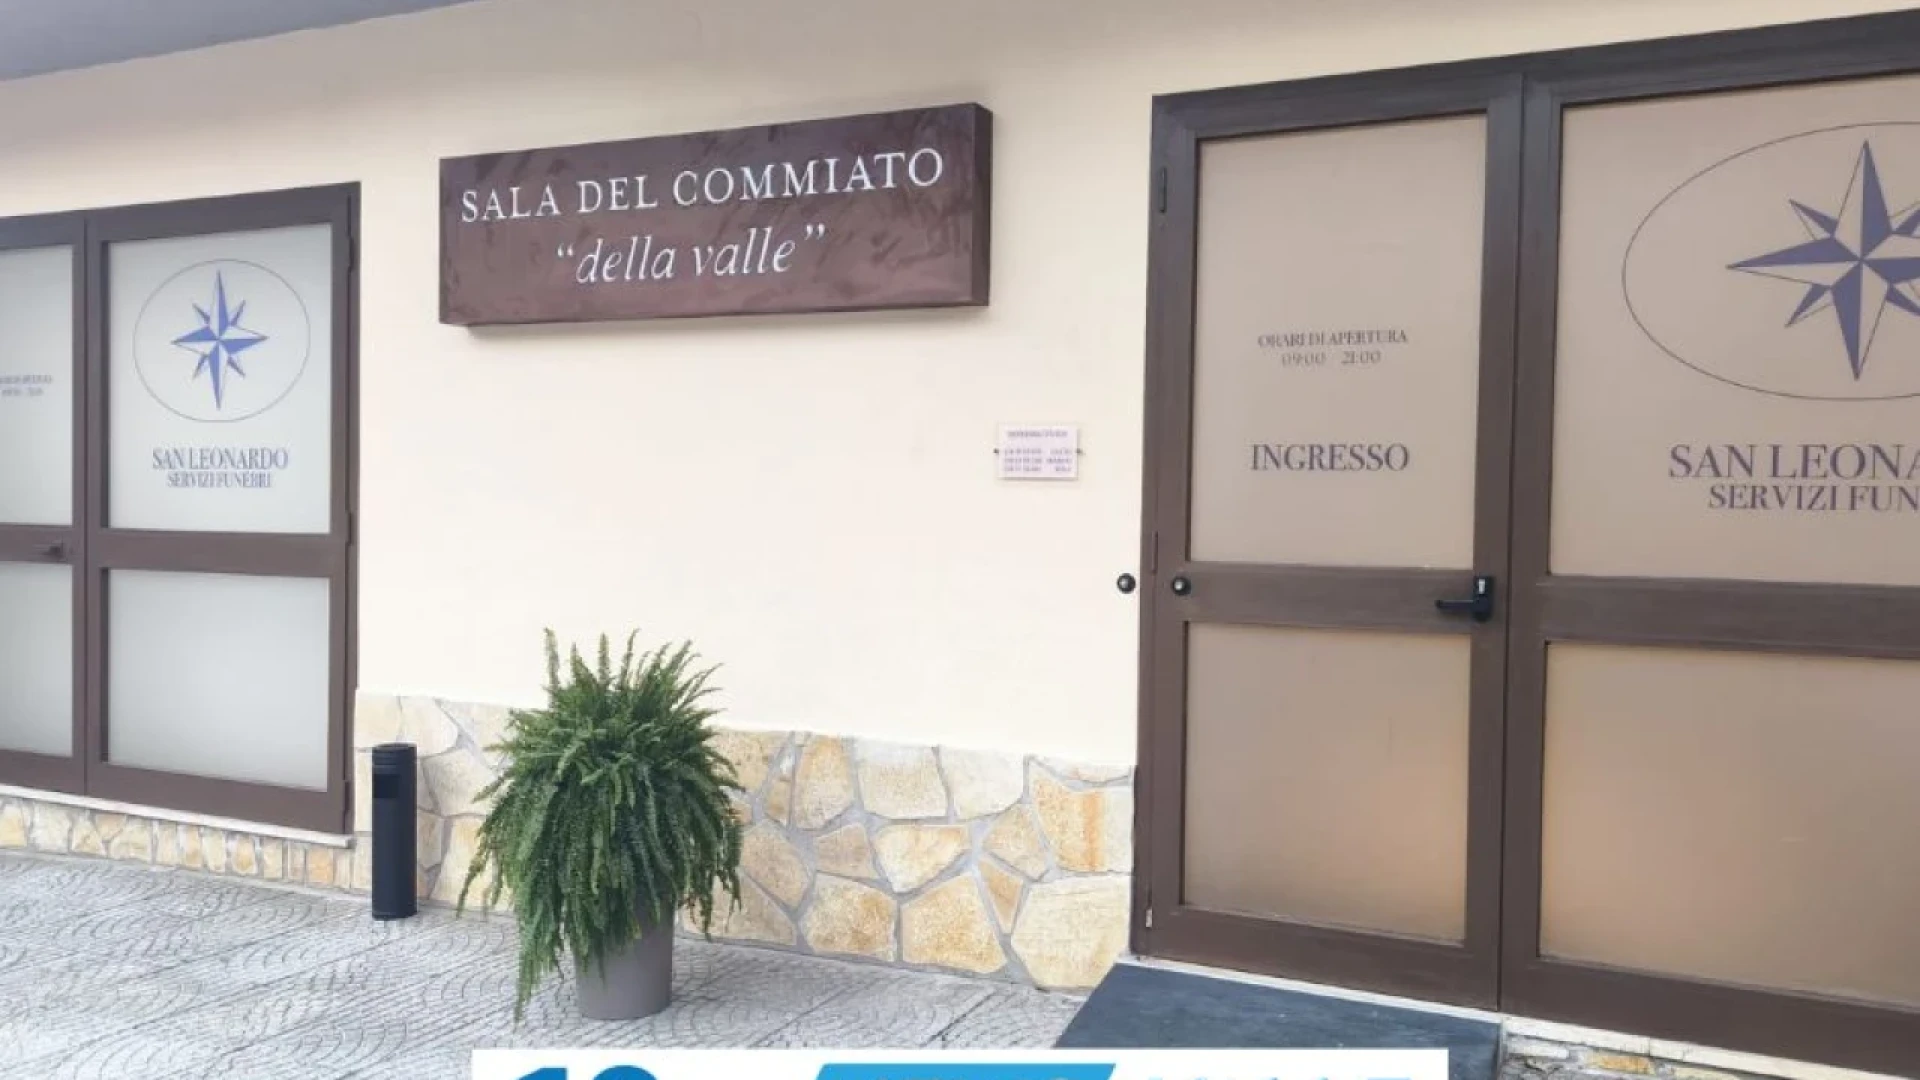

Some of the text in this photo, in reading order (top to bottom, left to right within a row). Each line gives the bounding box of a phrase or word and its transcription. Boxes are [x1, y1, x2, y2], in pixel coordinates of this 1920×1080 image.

[461, 147, 944, 223] SALA DEL COMMIATO
[1257, 328, 1408, 348] ORARI DI APERTURA
[152, 446, 289, 470] SAN LEONARDO
[1251, 442, 1410, 471] INGRESSO
[1668, 442, 1756, 478] SAN
[167, 471, 272, 488] SERVIZI FUNEBRI
[1708, 484, 1838, 511] SERVIZI
